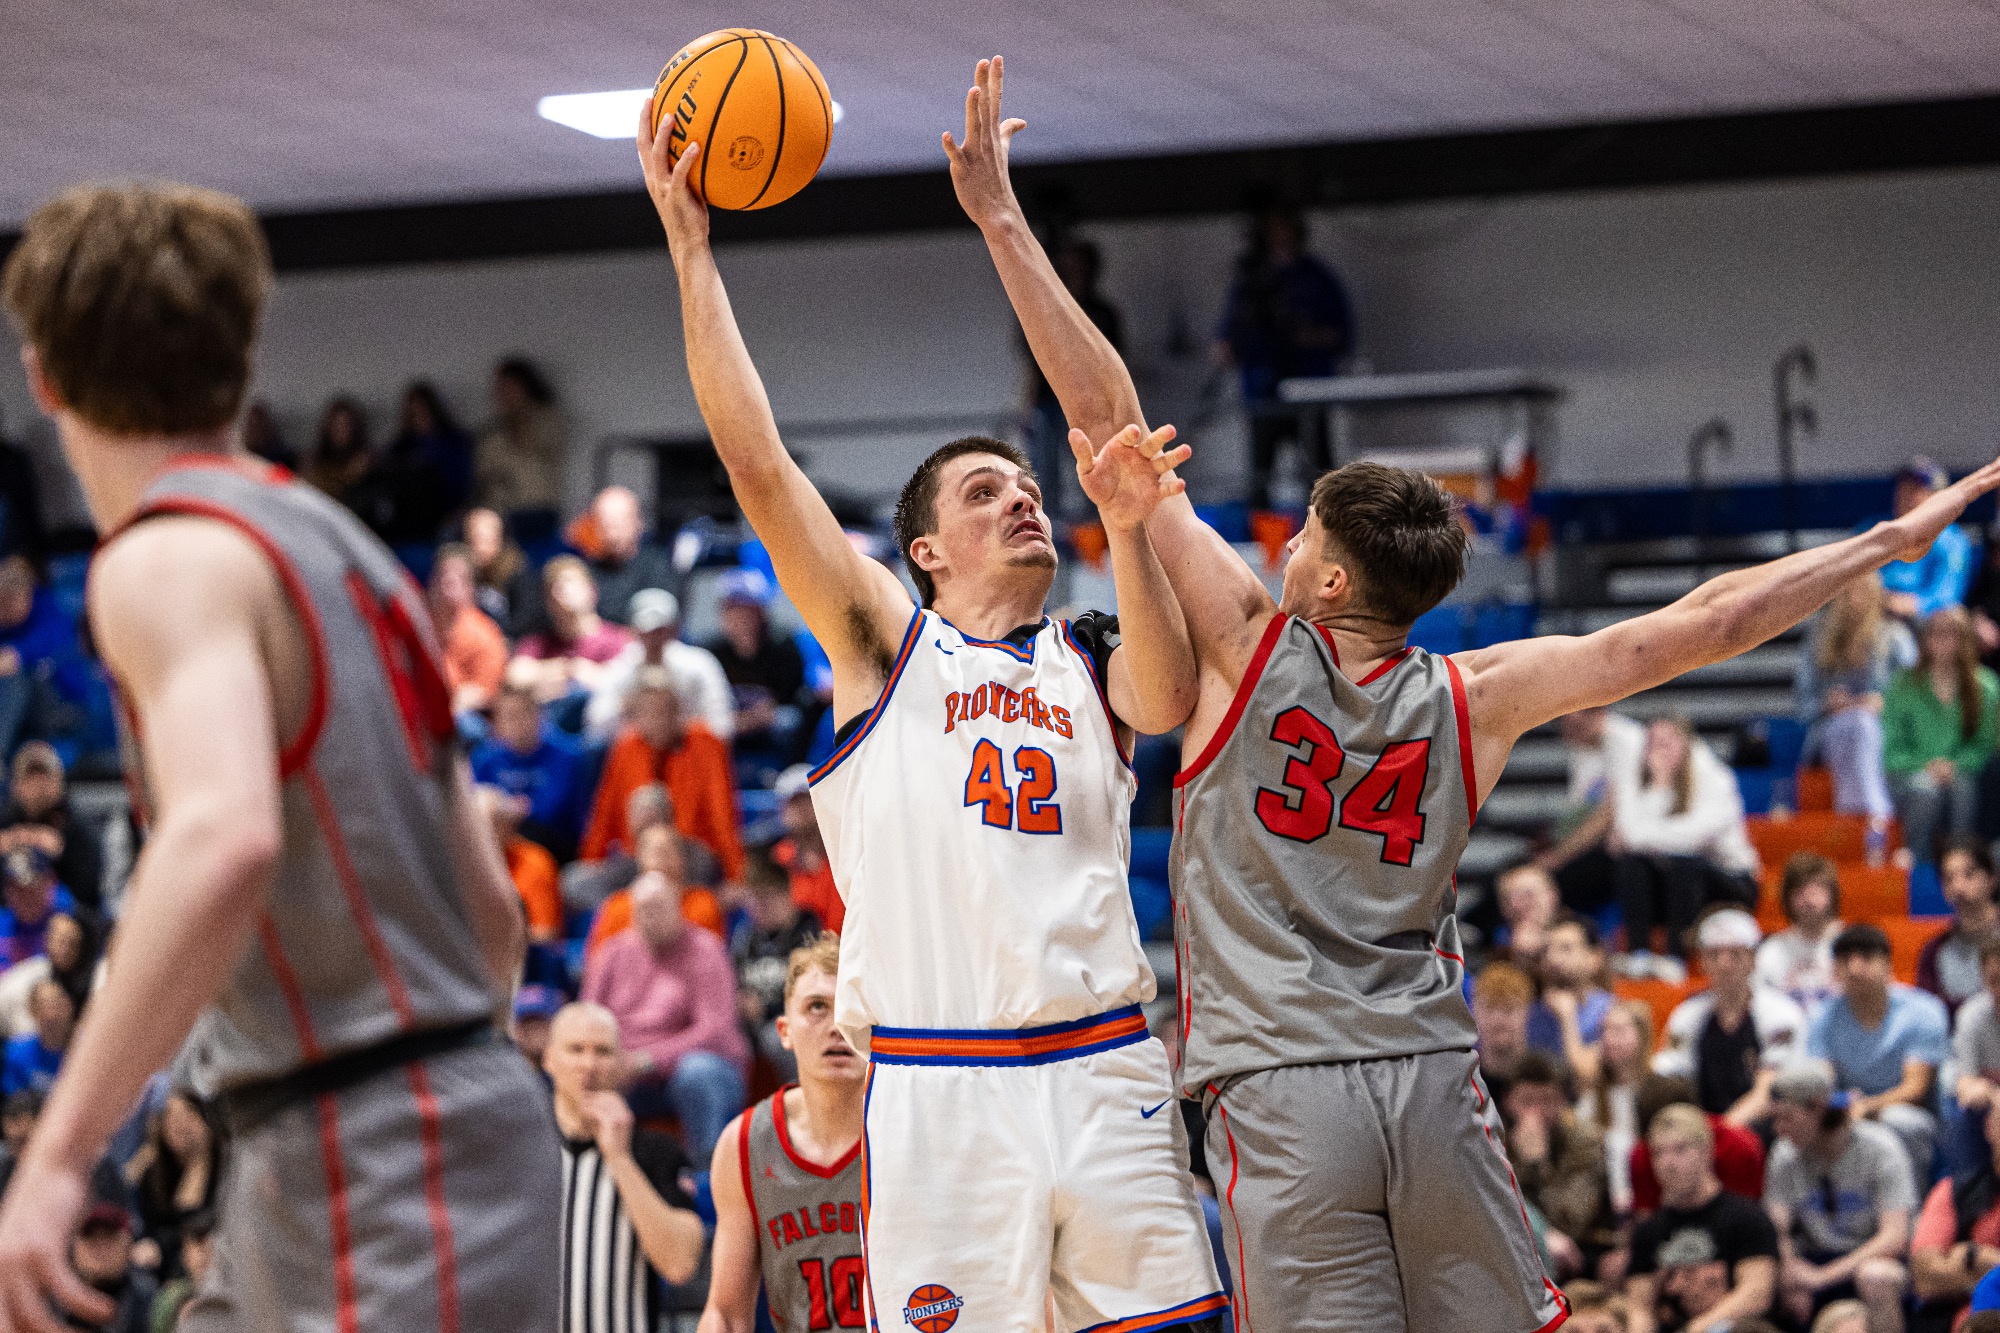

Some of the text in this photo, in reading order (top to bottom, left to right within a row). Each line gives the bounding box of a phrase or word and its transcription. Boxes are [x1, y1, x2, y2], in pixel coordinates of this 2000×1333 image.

[964, 737, 1064, 836] 42
[1254, 704, 1432, 868] 34
[767, 1202, 861, 1251] FALCO
[797, 1254, 867, 1331] 10
[902, 1296, 965, 1325] PIONEERS
